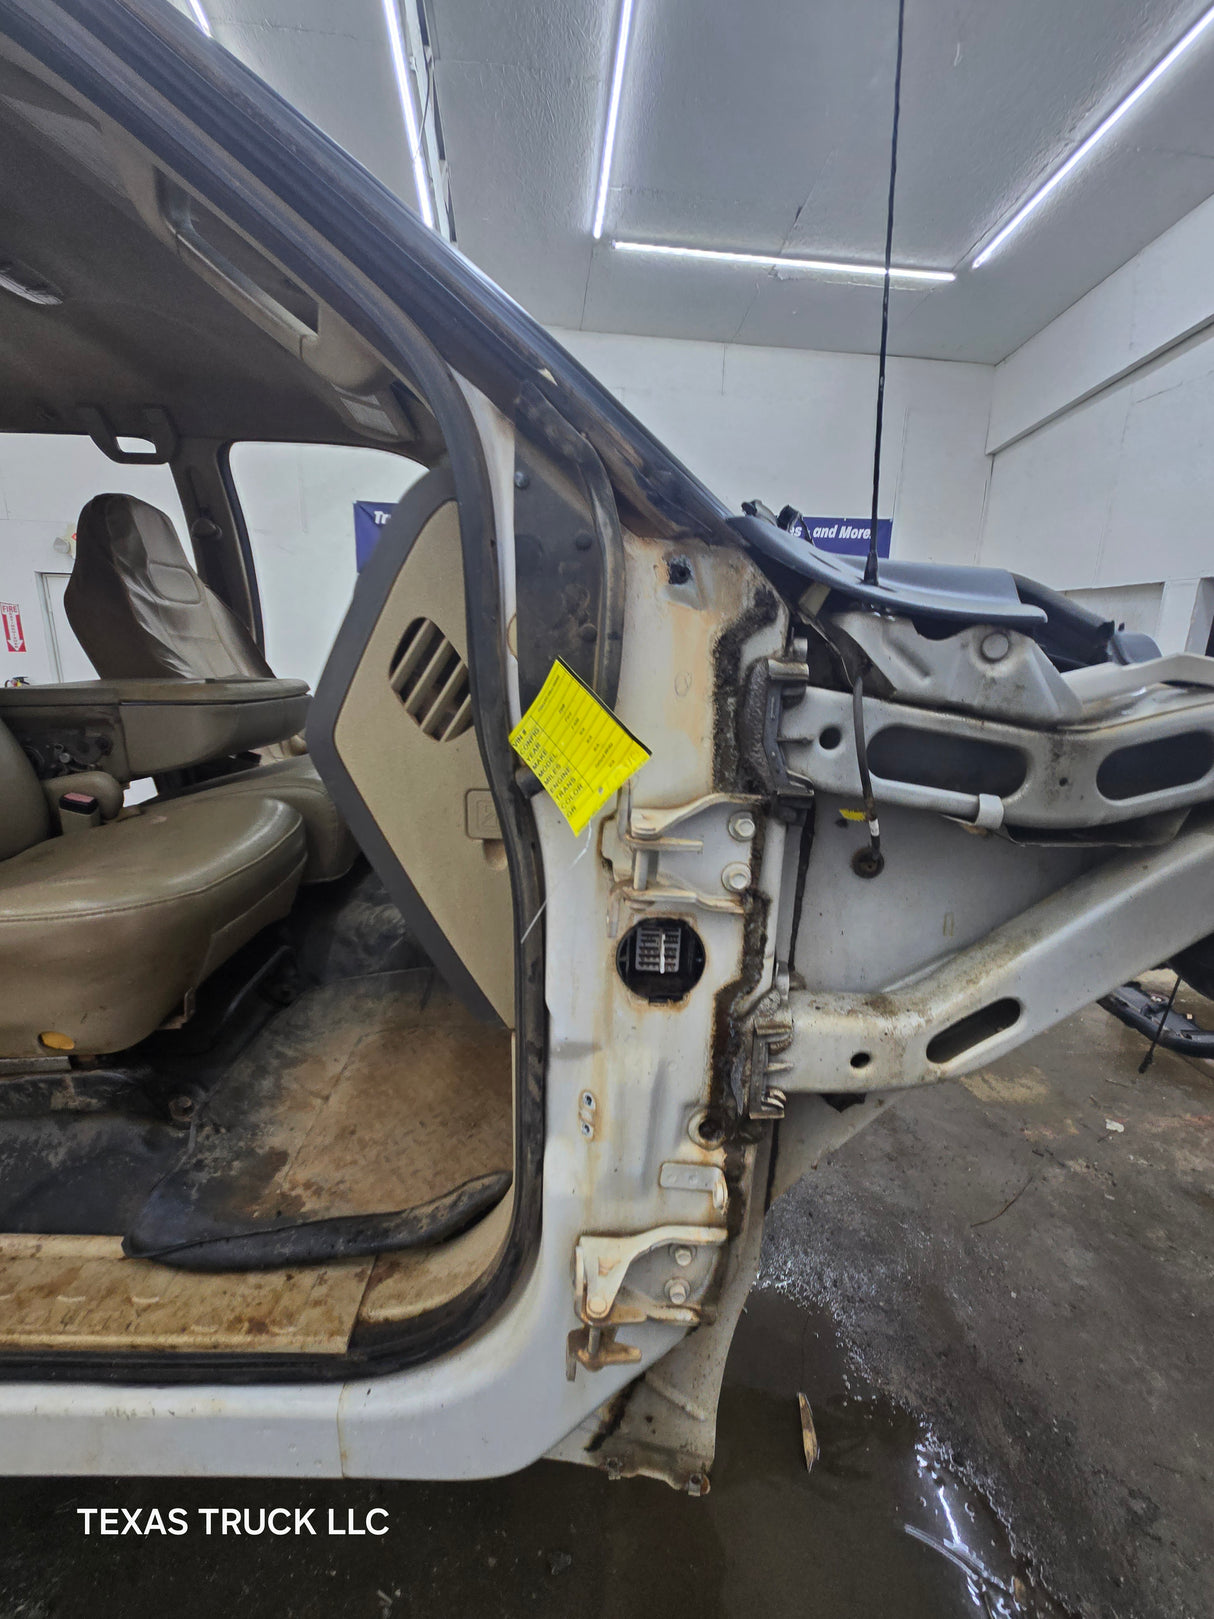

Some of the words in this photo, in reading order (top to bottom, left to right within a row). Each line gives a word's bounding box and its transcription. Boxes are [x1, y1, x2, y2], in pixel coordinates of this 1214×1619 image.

[813, 524, 839, 538] and
[513, 735, 524, 748] VIN
[519, 727, 540, 755] CONFIG
[527, 741, 541, 762] YEAR
[532, 750, 548, 770] MAKE
[538, 753, 557, 778] MODEL
[544, 763, 561, 785] MILES
[549, 766, 571, 794] ENGINE
[555, 777, 576, 801] TRANS
[561, 783, 583, 809] COLOR
